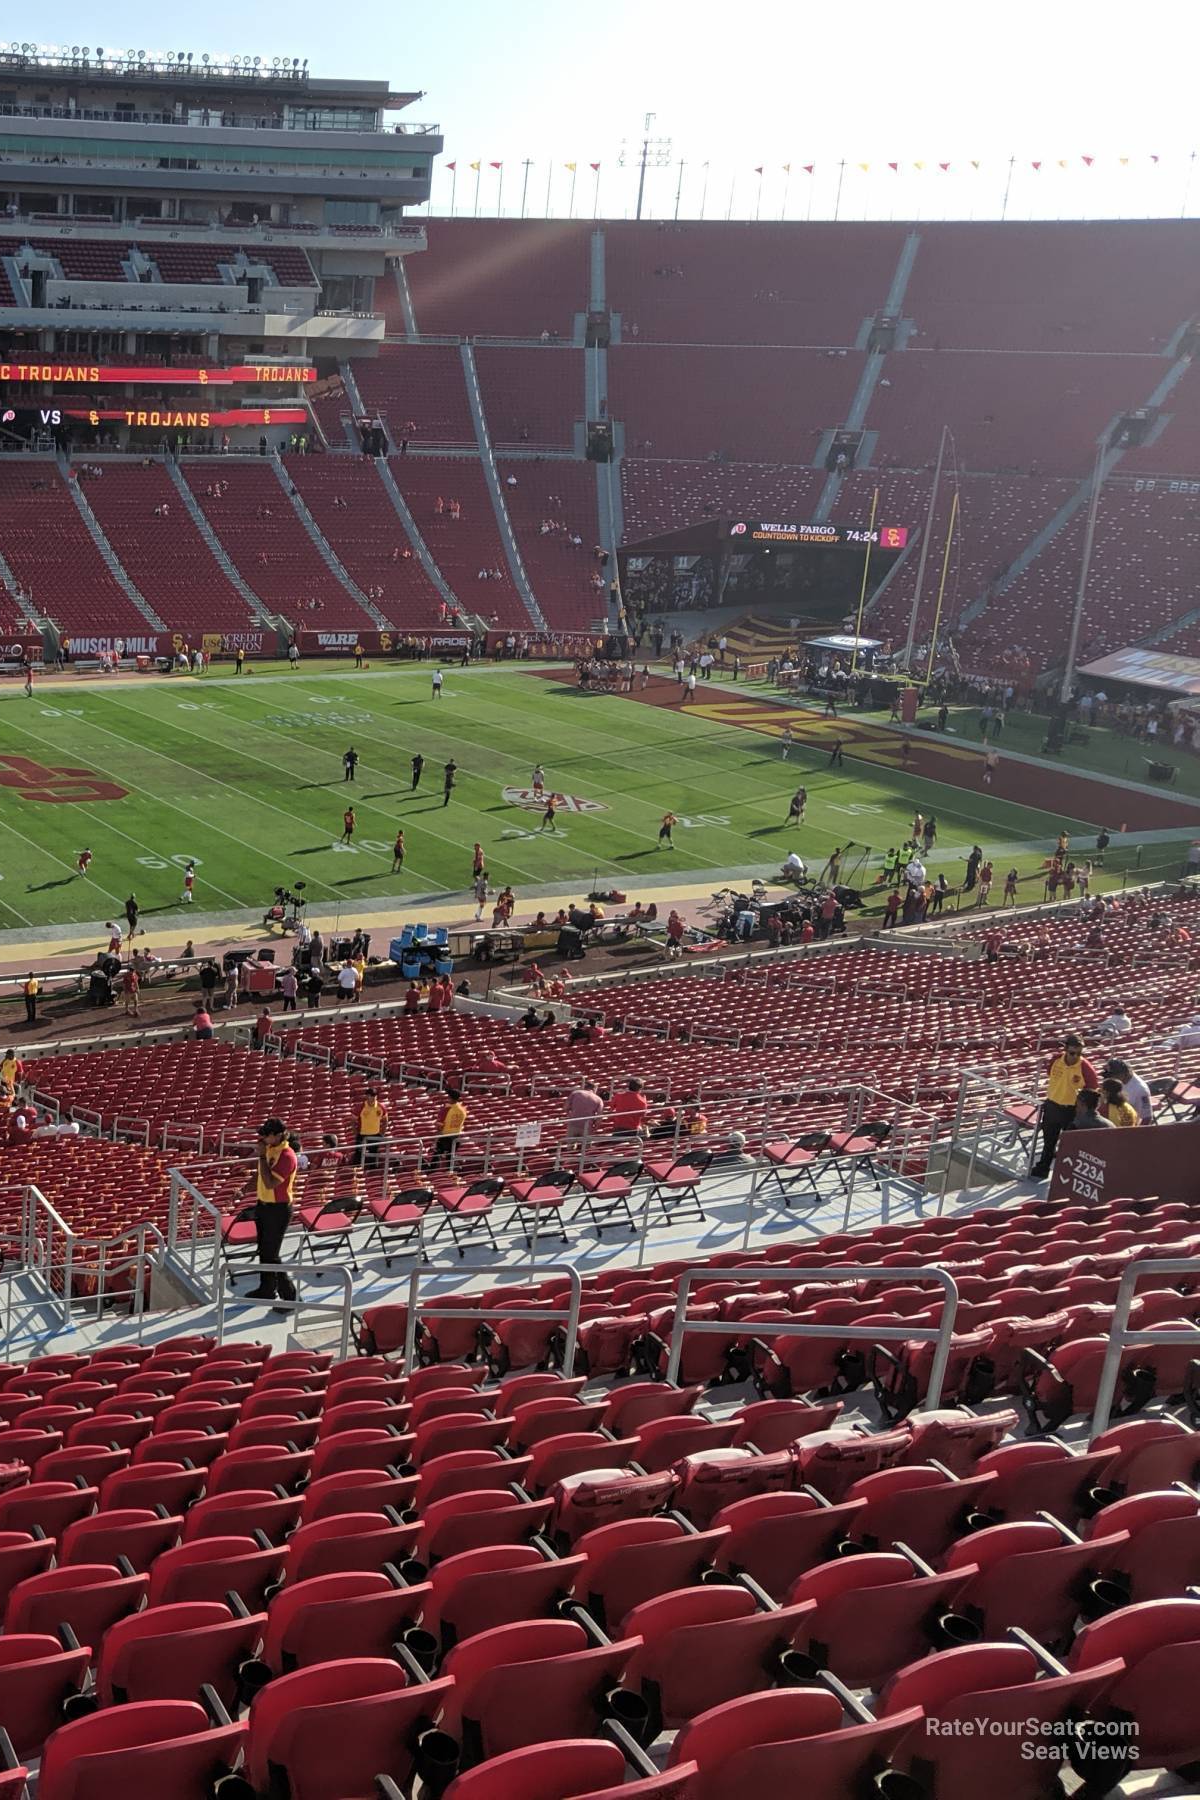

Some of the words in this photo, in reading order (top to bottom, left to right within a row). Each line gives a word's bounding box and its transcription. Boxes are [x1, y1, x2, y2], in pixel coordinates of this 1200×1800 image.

[18, 366, 99, 382] TROJANS
[255, 367, 309, 382] TROJANS
[40, 410, 61, 424] VS
[126, 411, 210, 427] TROJANS
[760, 523, 796, 533] WELLS
[800, 525, 835, 535] FARGO
[846, 530, 878, 542] 74:24
[752, 531, 798, 542] COUNTDOWN
[800, 533, 809, 542] TO
[810, 534, 840, 543] KICKOFF
[226, 632, 264, 641] CREDIT
[317, 633, 359, 645] WARE
[126, 637, 158, 653] MILK
[1073, 1159, 1105, 1184] 223A
[1072, 1178, 1100, 1202] 123A
